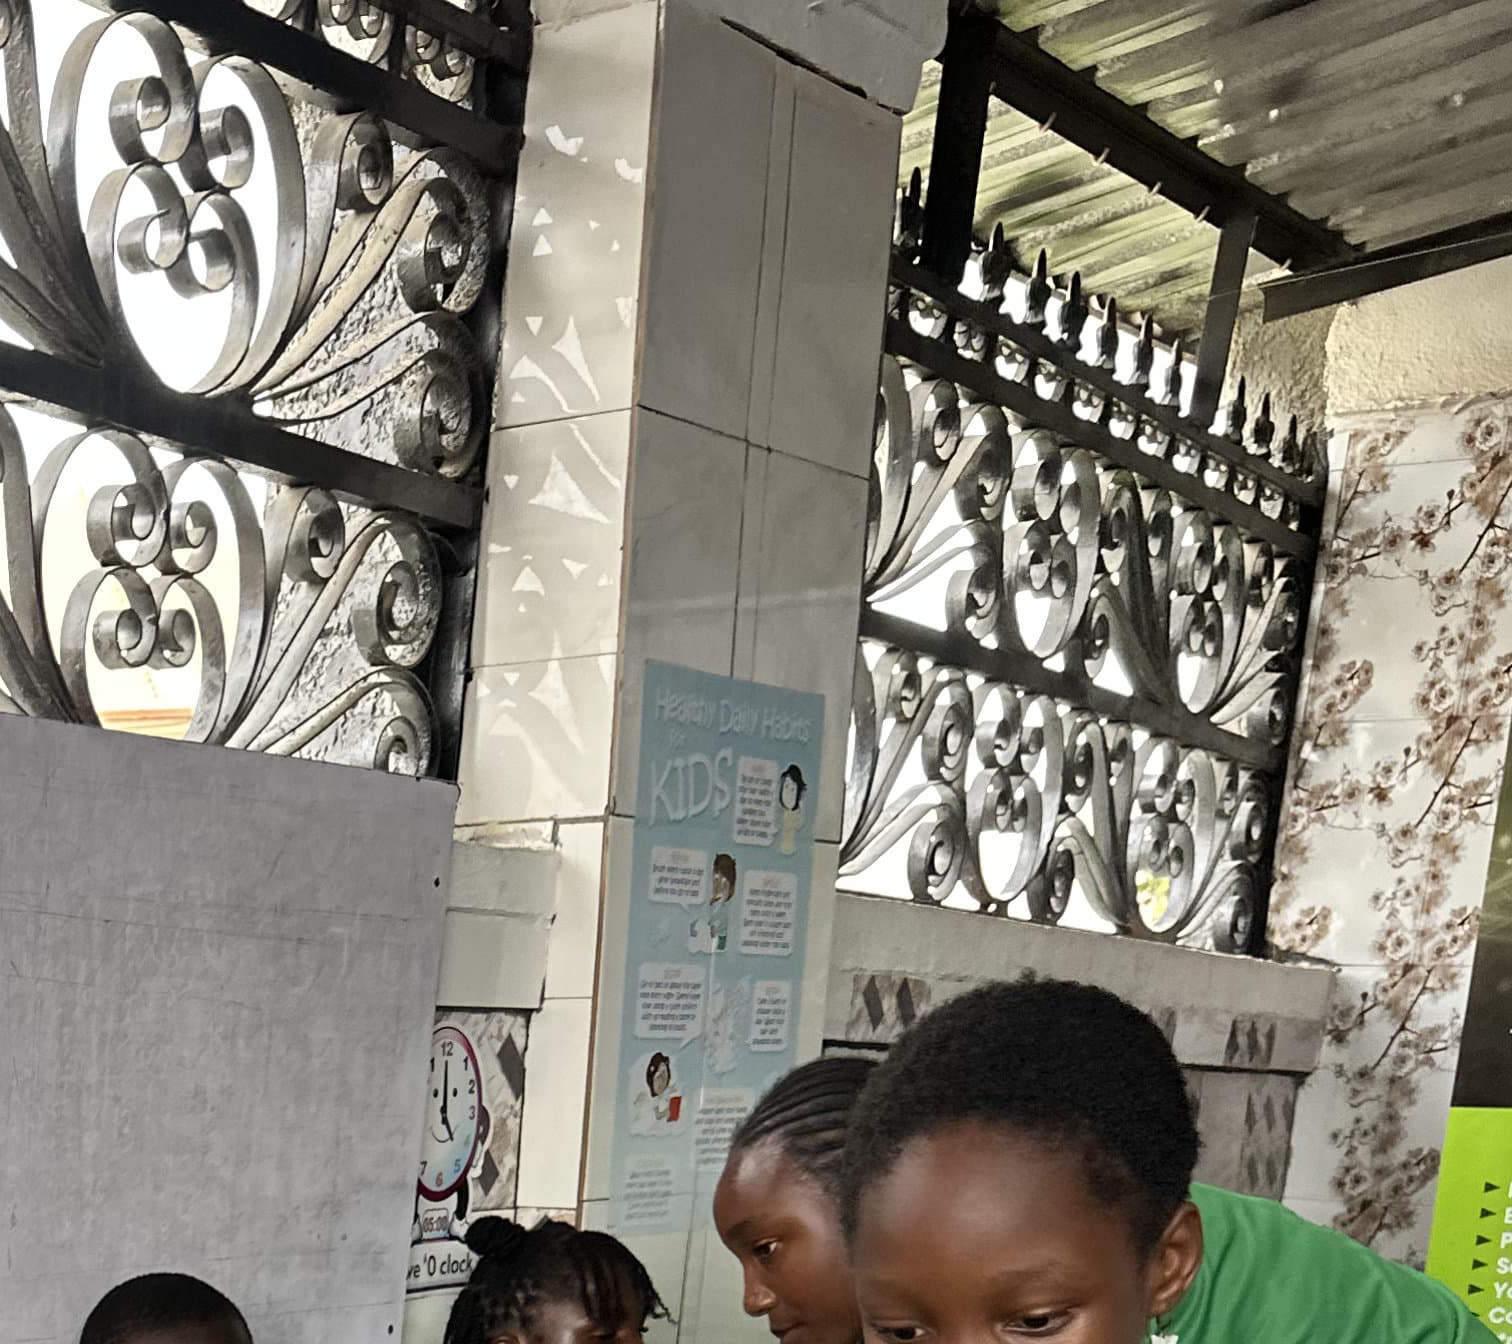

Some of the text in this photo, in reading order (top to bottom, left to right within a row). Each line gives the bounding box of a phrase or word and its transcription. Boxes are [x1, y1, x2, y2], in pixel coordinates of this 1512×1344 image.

[719, 700, 759, 736] Daily
[762, 705, 812, 743] Habits
[648, 746, 733, 826] KIDS
[441, 1041, 453, 1056] 12
[464, 1056, 468, 1071] 1
[469, 1079, 475, 1094] 2
[469, 1106, 475, 1120] 3
[420, 1160, 428, 1175] 7
[454, 1158, 461, 1174] 5
[436, 1172, 443, 1187] 6
[407, 1264, 420, 1280] ve
[440, 1256, 474, 1274] clock
